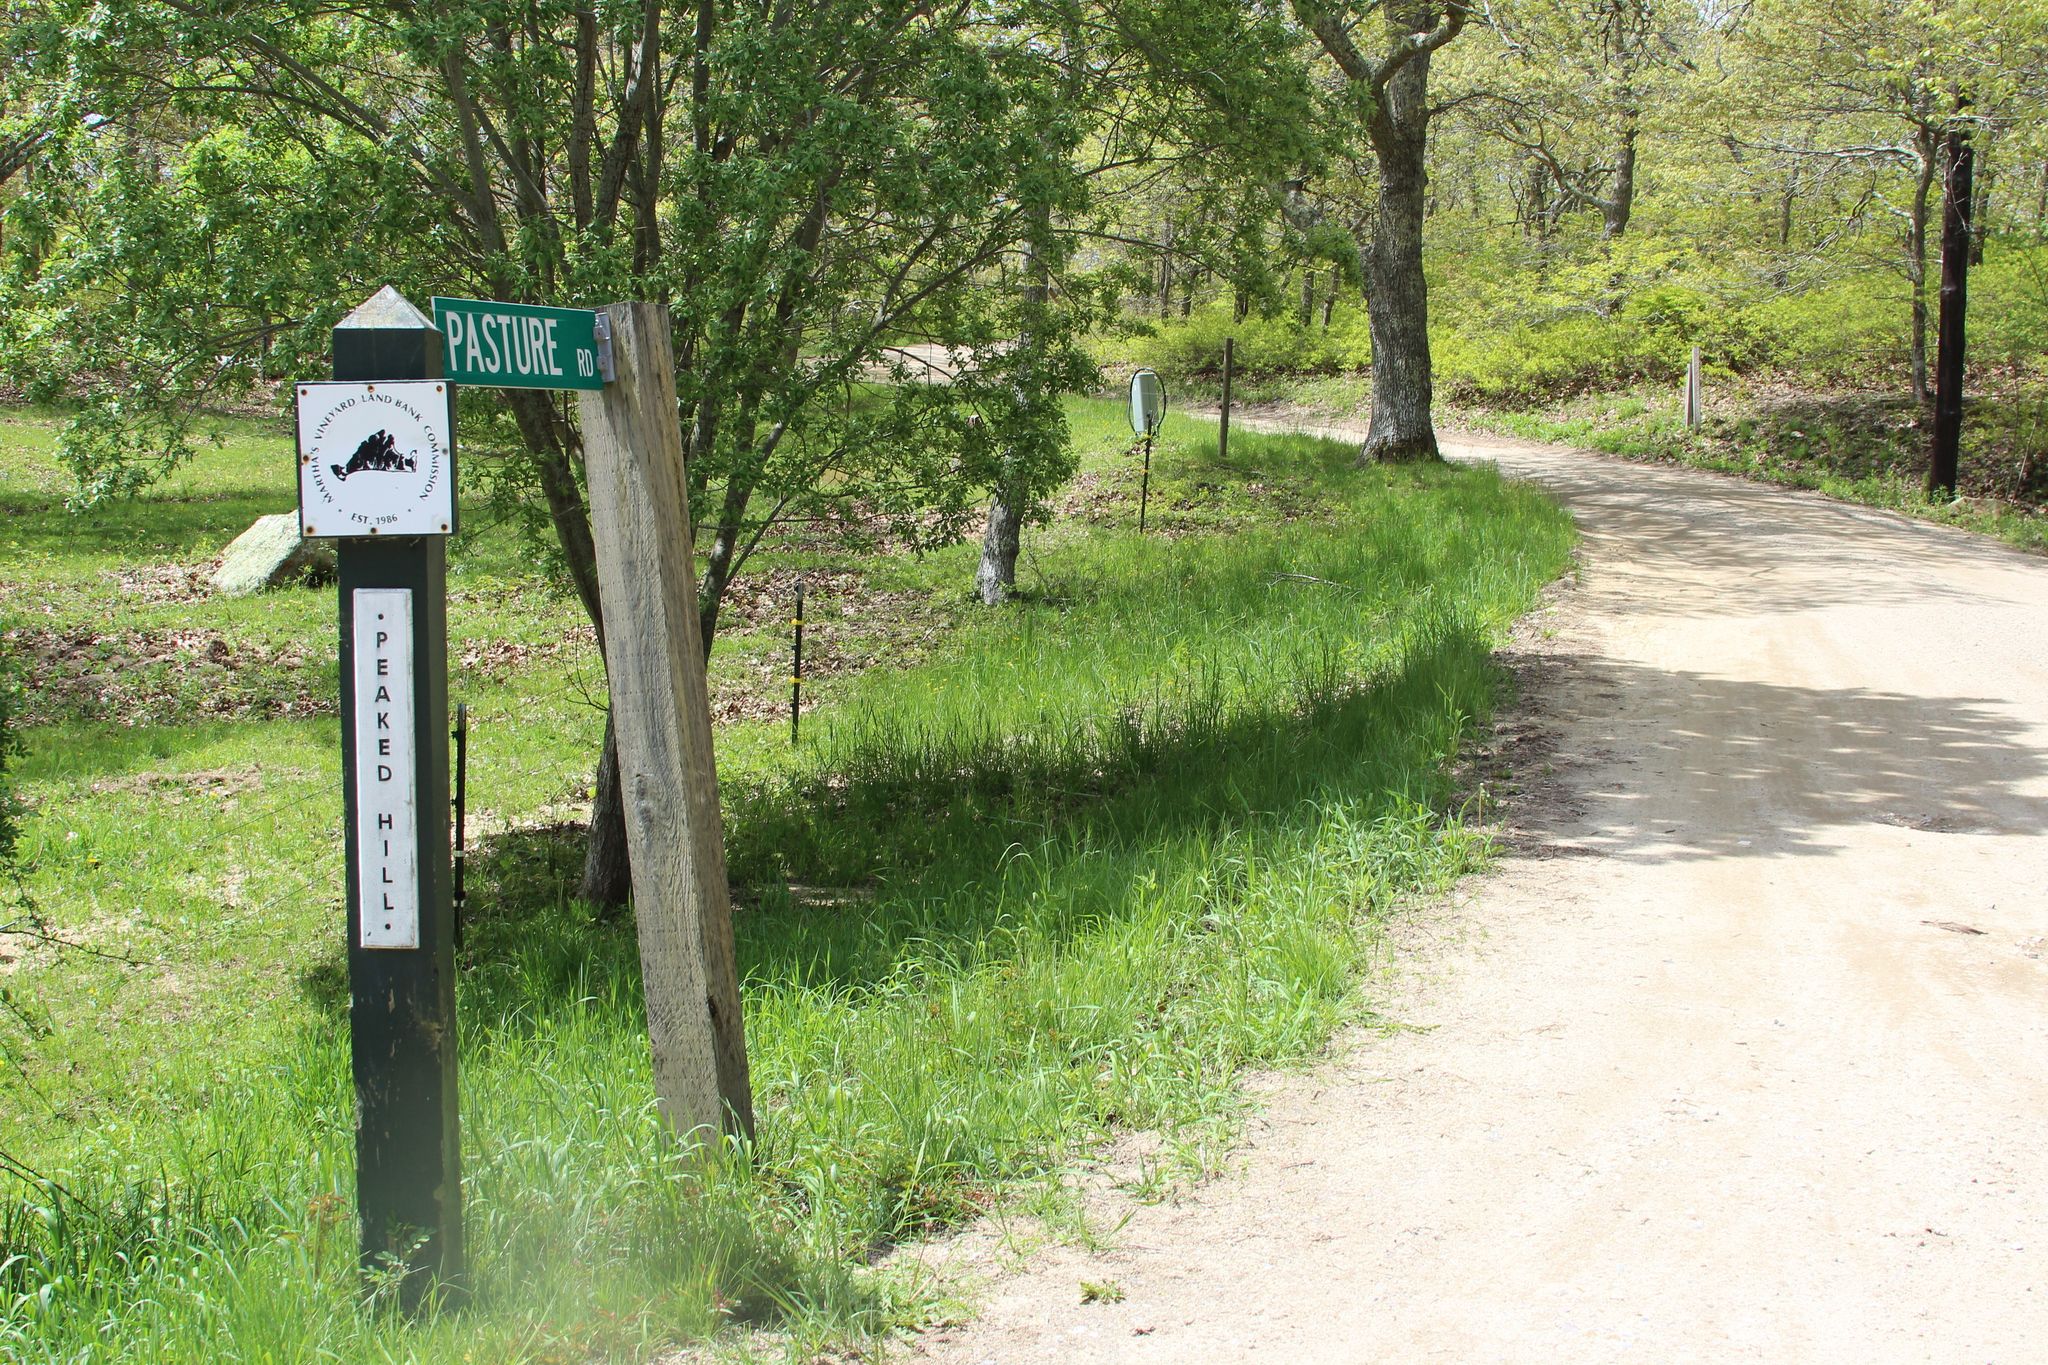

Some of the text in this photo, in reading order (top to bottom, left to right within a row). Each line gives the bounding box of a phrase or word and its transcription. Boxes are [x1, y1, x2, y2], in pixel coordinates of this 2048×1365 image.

[446, 311, 594, 377] PASTURE RD
[311, 393, 439, 504] MARTHA'S VINEYARD LAND BANK COMMISSION
[351, 512, 398, 525] EST. 1986
[375, 631, 394, 910] PEAKED HILL
